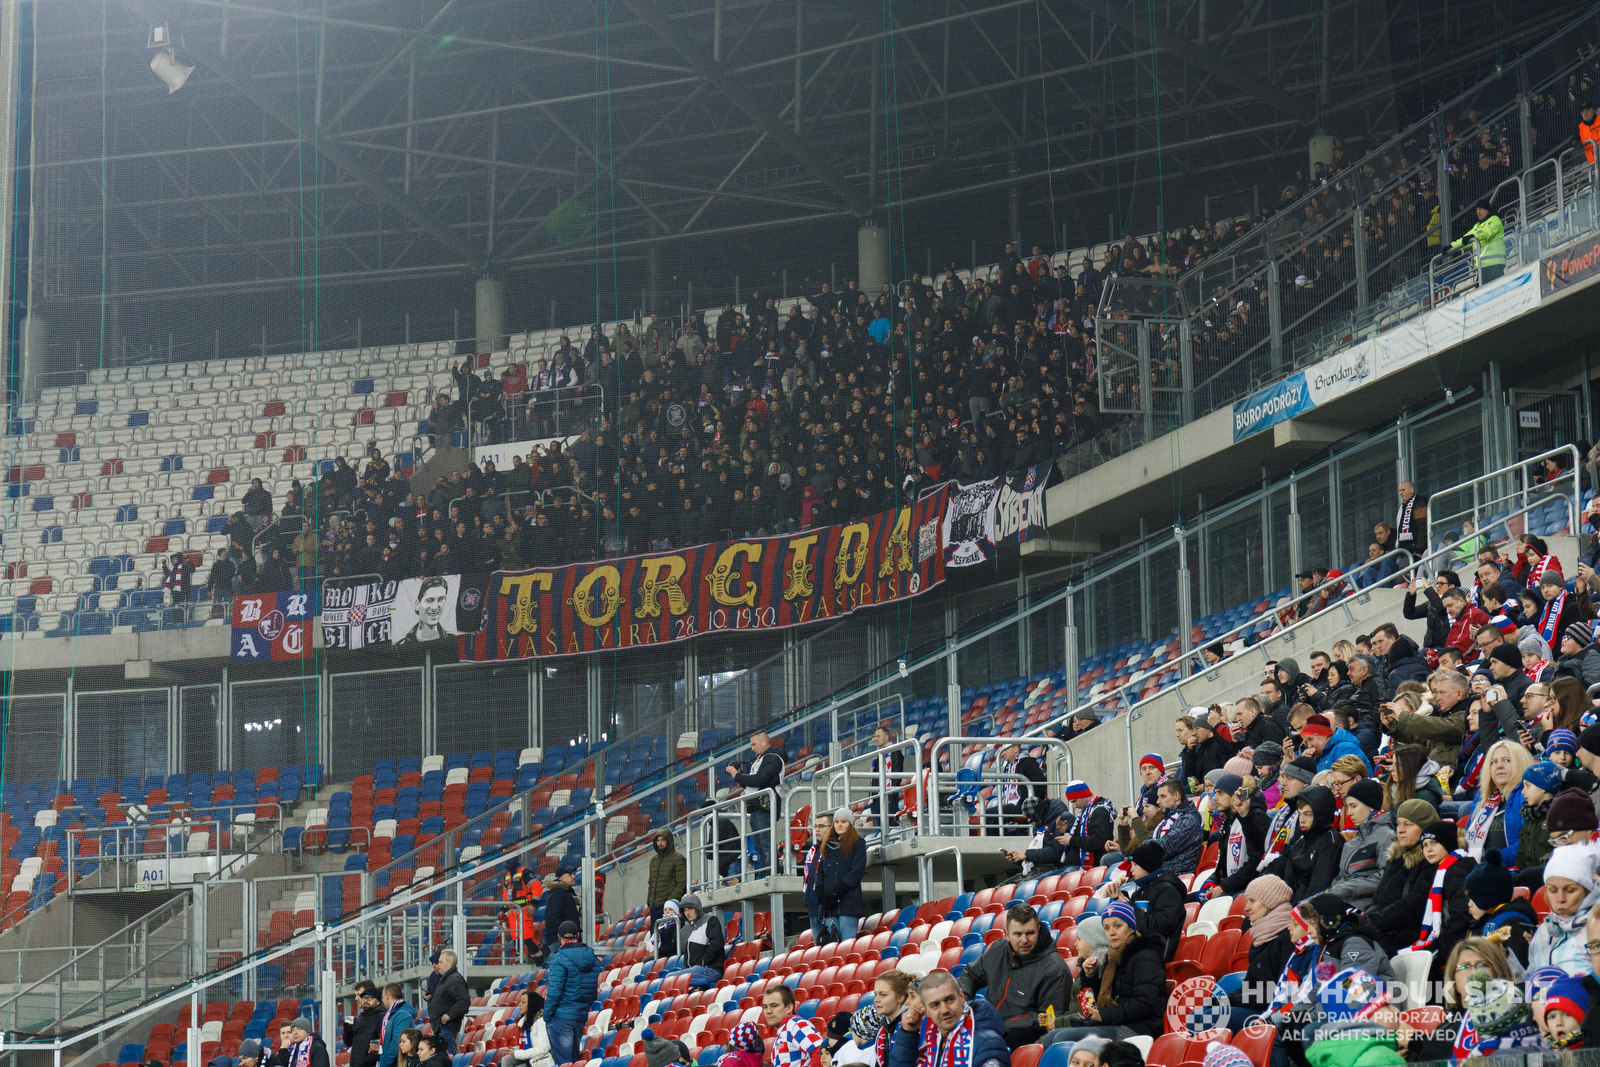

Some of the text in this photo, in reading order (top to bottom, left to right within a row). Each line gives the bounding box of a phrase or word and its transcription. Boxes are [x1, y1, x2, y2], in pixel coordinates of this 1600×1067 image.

[1313, 364, 1354, 391] Brendan
[1235, 385, 1303, 430] BIURO PODRÓŻY
[480, 453, 499, 465] A11
[499, 507, 914, 634] TORCIDA
[675, 607, 776, 639] 28. 10. 1950.
[500, 622, 657, 658] VAŠA VIRA
[142, 869, 164, 881] A01
